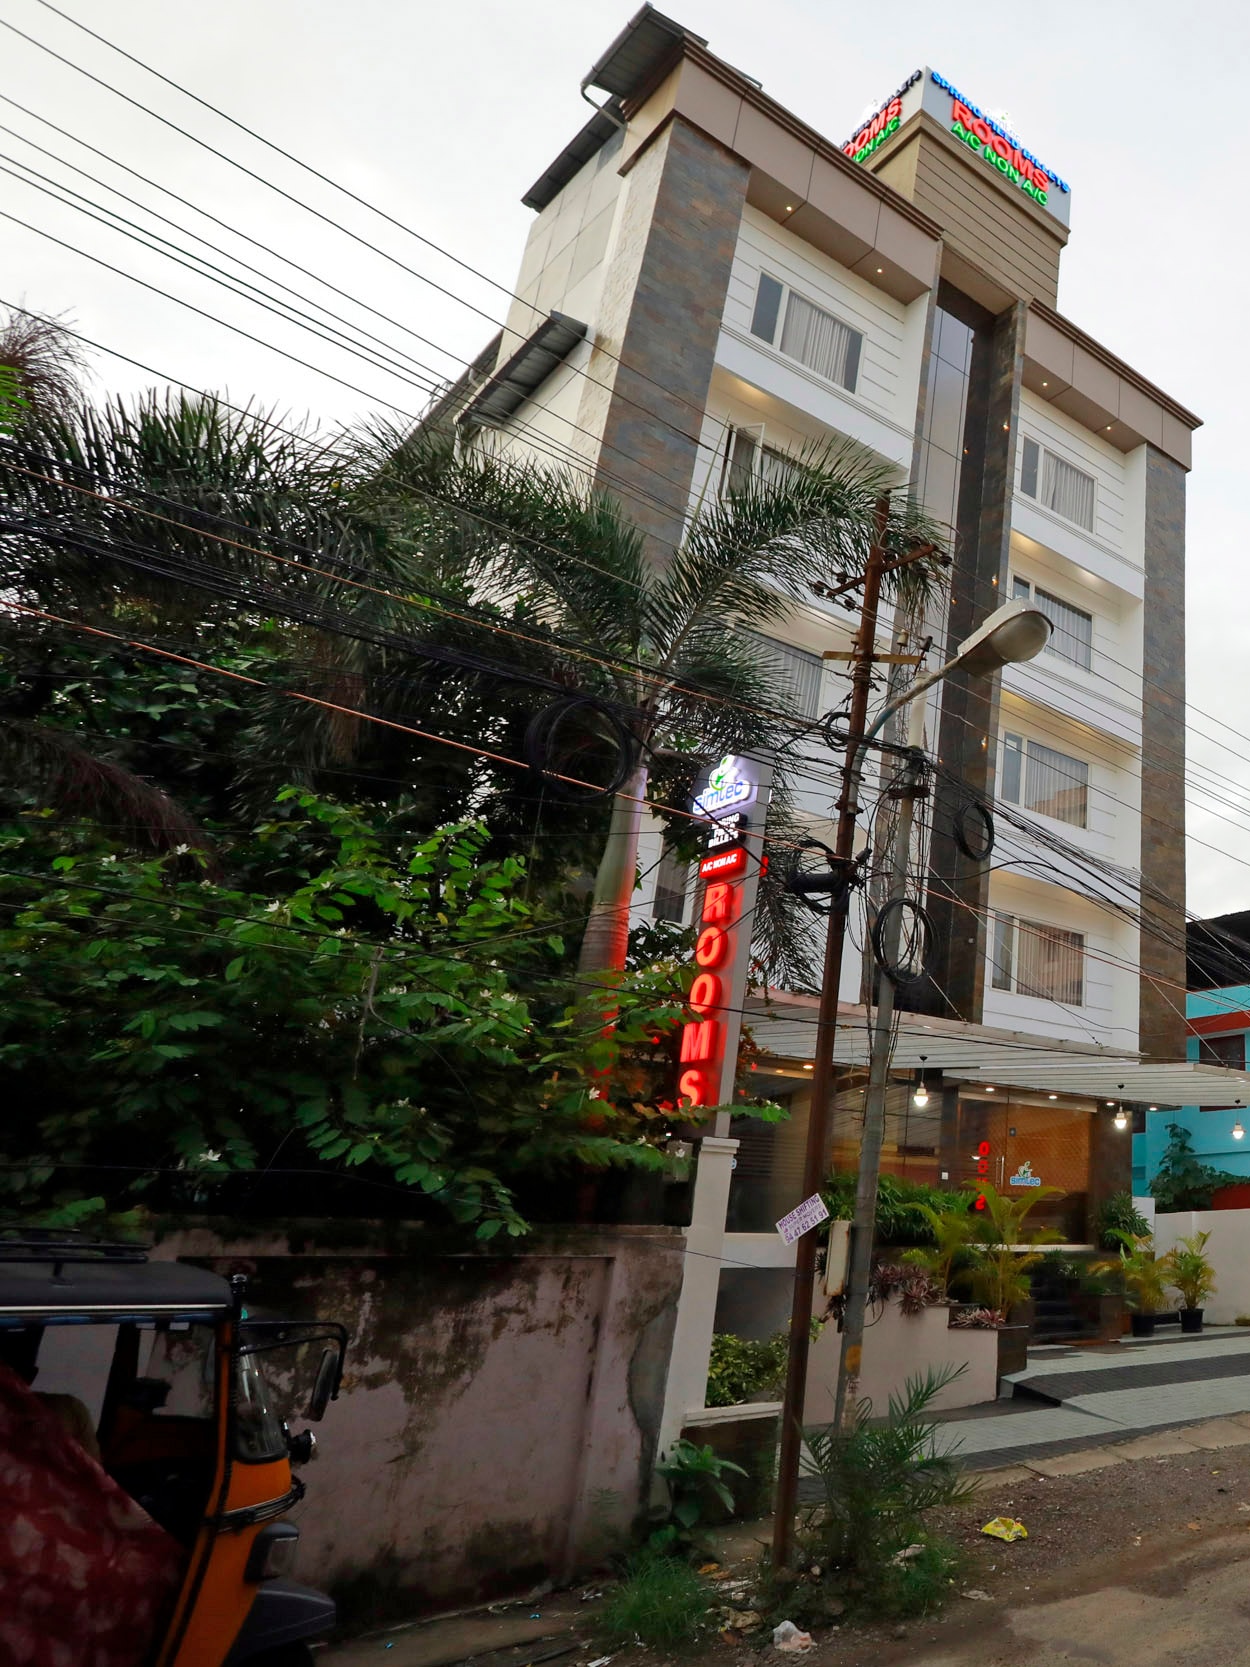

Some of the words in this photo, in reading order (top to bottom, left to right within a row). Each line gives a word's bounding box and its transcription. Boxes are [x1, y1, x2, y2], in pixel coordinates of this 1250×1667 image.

[843, 97, 902, 157] OOMS
[853, 138, 877, 163] ON
[931, 71, 982, 119] SPRING
[984, 116, 1021, 150] FIELD
[1021, 148, 1070, 194] BILLETS
[952, 99, 1049, 193] ROOMS
[951, 121, 982, 151] A/C
[983, 145, 1020, 184] NON
[1021, 178, 1048, 206] A/C
[694, 776, 744, 812] simtec
[678, 881, 731, 1108] ROOMS
[778, 1211, 797, 1230] HOUSE
[795, 1194, 820, 1216] SHIFTING
